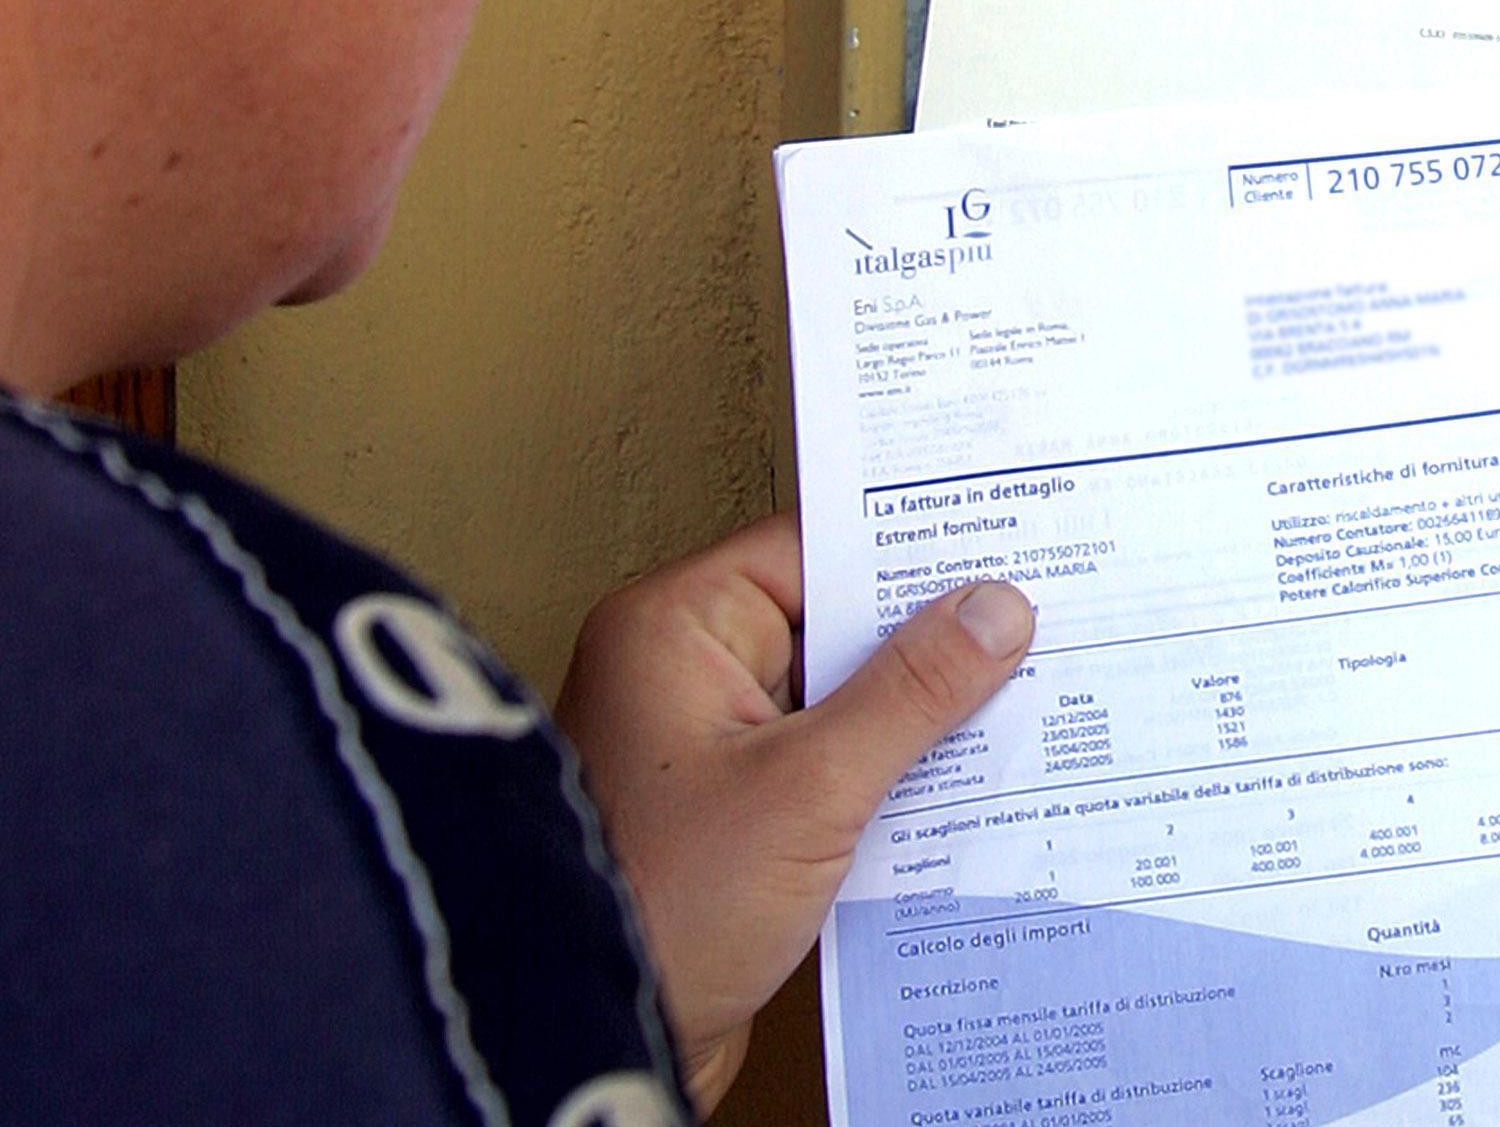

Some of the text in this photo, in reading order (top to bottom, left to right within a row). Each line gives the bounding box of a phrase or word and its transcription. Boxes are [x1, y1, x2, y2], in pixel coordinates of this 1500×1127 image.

[1242, 170, 1299, 187] Numero
[1328, 166, 1380, 194] 210
[1390, 159, 1443, 187] 755
[1243, 188, 1294, 204] Cliente
[854, 298, 878, 316] Eni
[1266, 467, 1394, 496] Caratteristiche
[1421, 453, 1499, 477] fornitura
[899, 491, 961, 514] fattura
[989, 477, 1075, 508] dettaglio
[875, 513, 1017, 547] Estremi fornitura
[1013, 542, 1115, 566] 210755072101
[999, 567, 1041, 584] ANNA
[1045, 559, 1098, 578] MARIA
[1191, 672, 1240, 689] Valore
[1058, 690, 1094, 706] Data
[897, 918, 1091, 958] Calcolo degli importi
[1366, 918, 1441, 943] Quantità
[899, 975, 999, 1001] Descrizione
